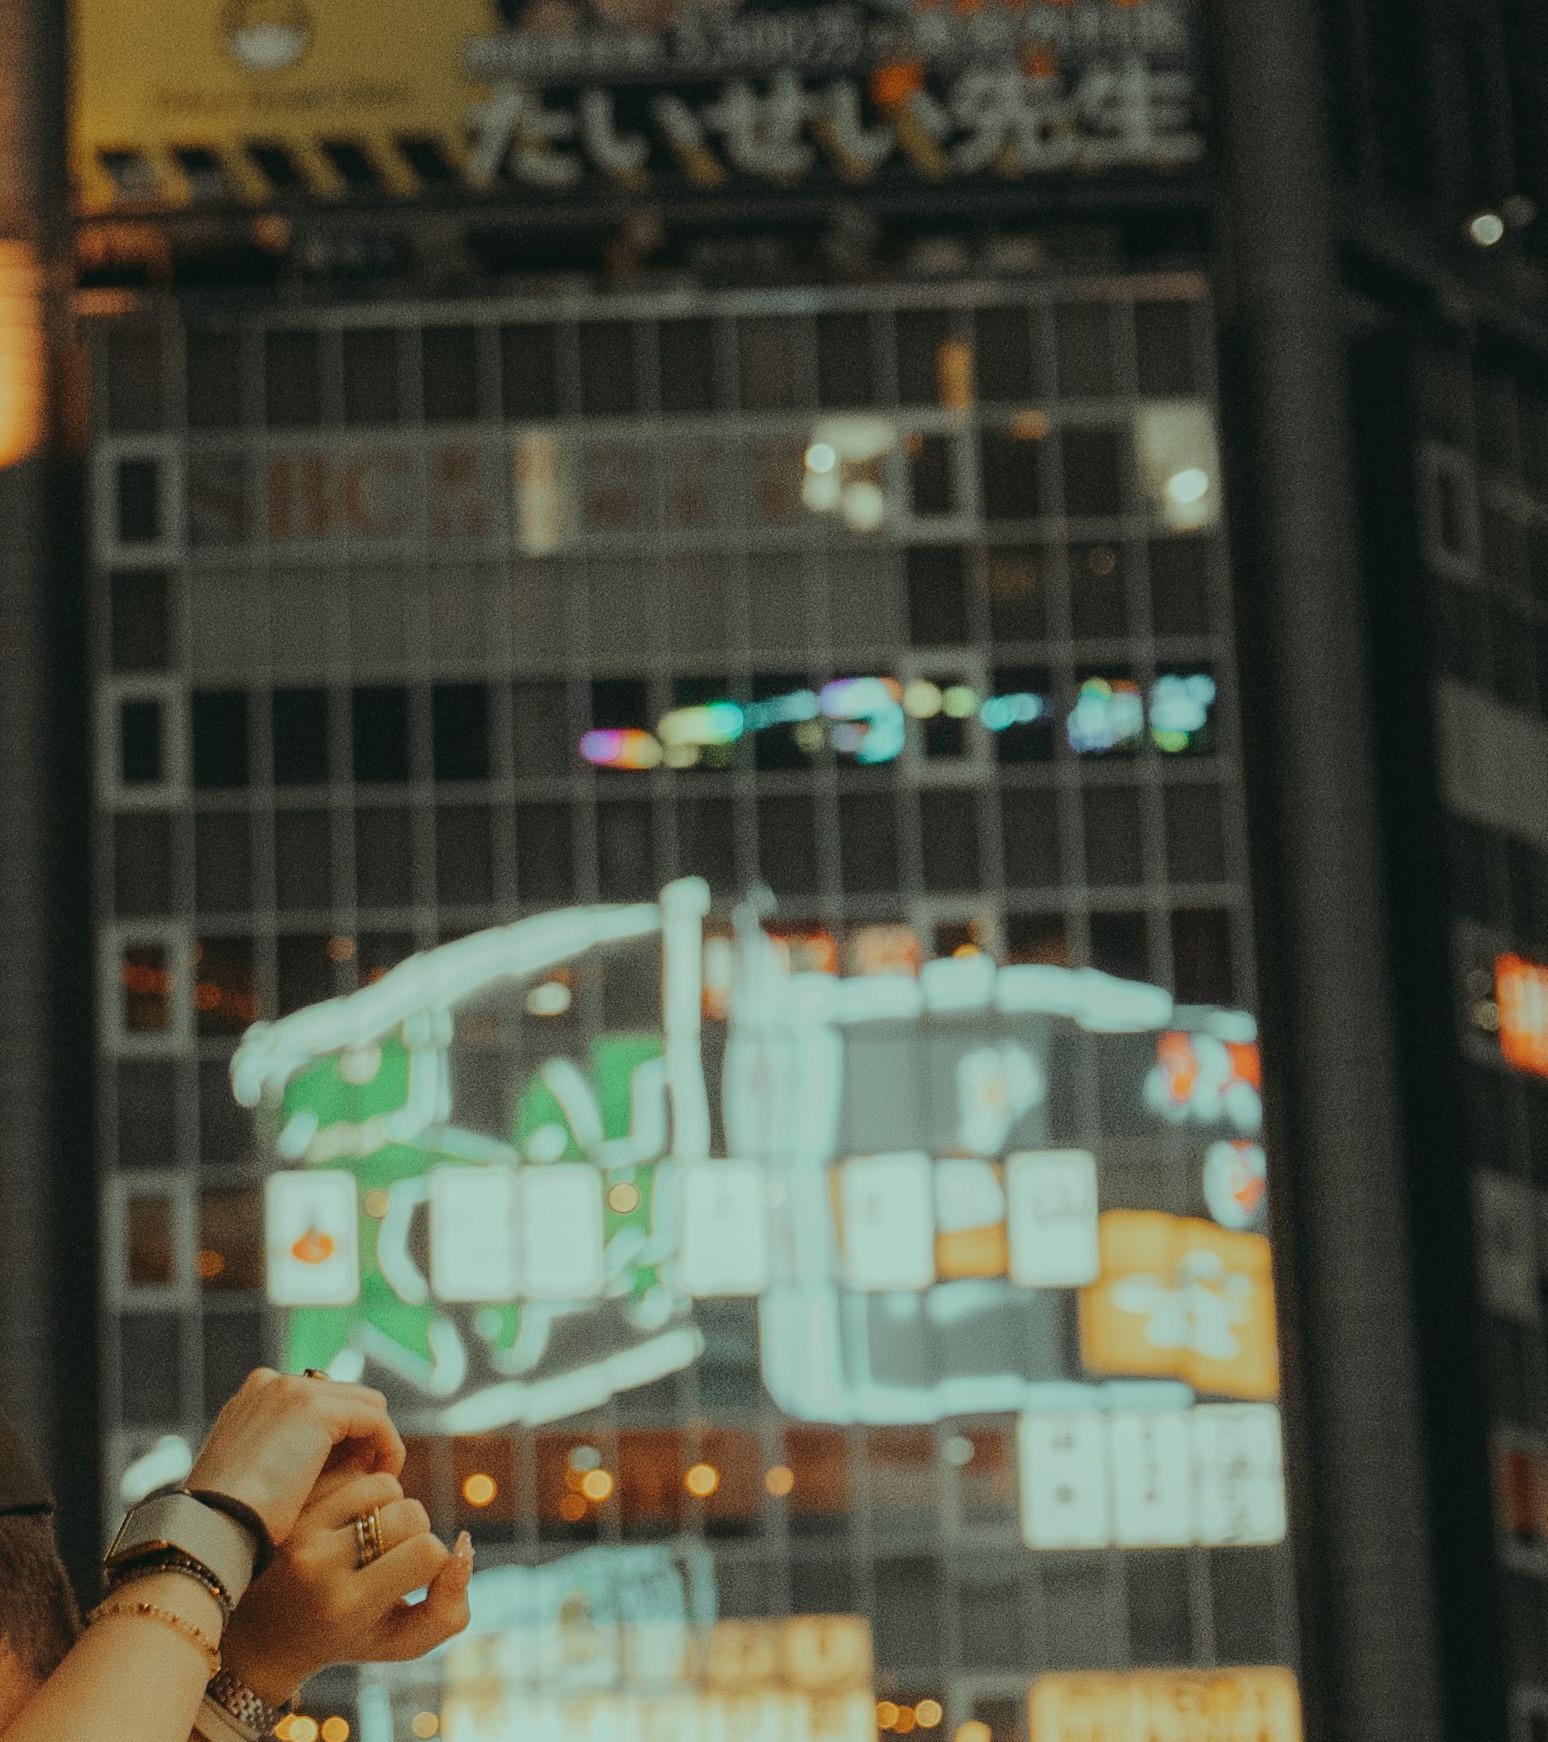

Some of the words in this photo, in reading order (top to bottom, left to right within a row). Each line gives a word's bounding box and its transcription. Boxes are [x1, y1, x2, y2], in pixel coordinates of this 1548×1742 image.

[462, 55, 1206, 186] たいせい先生
